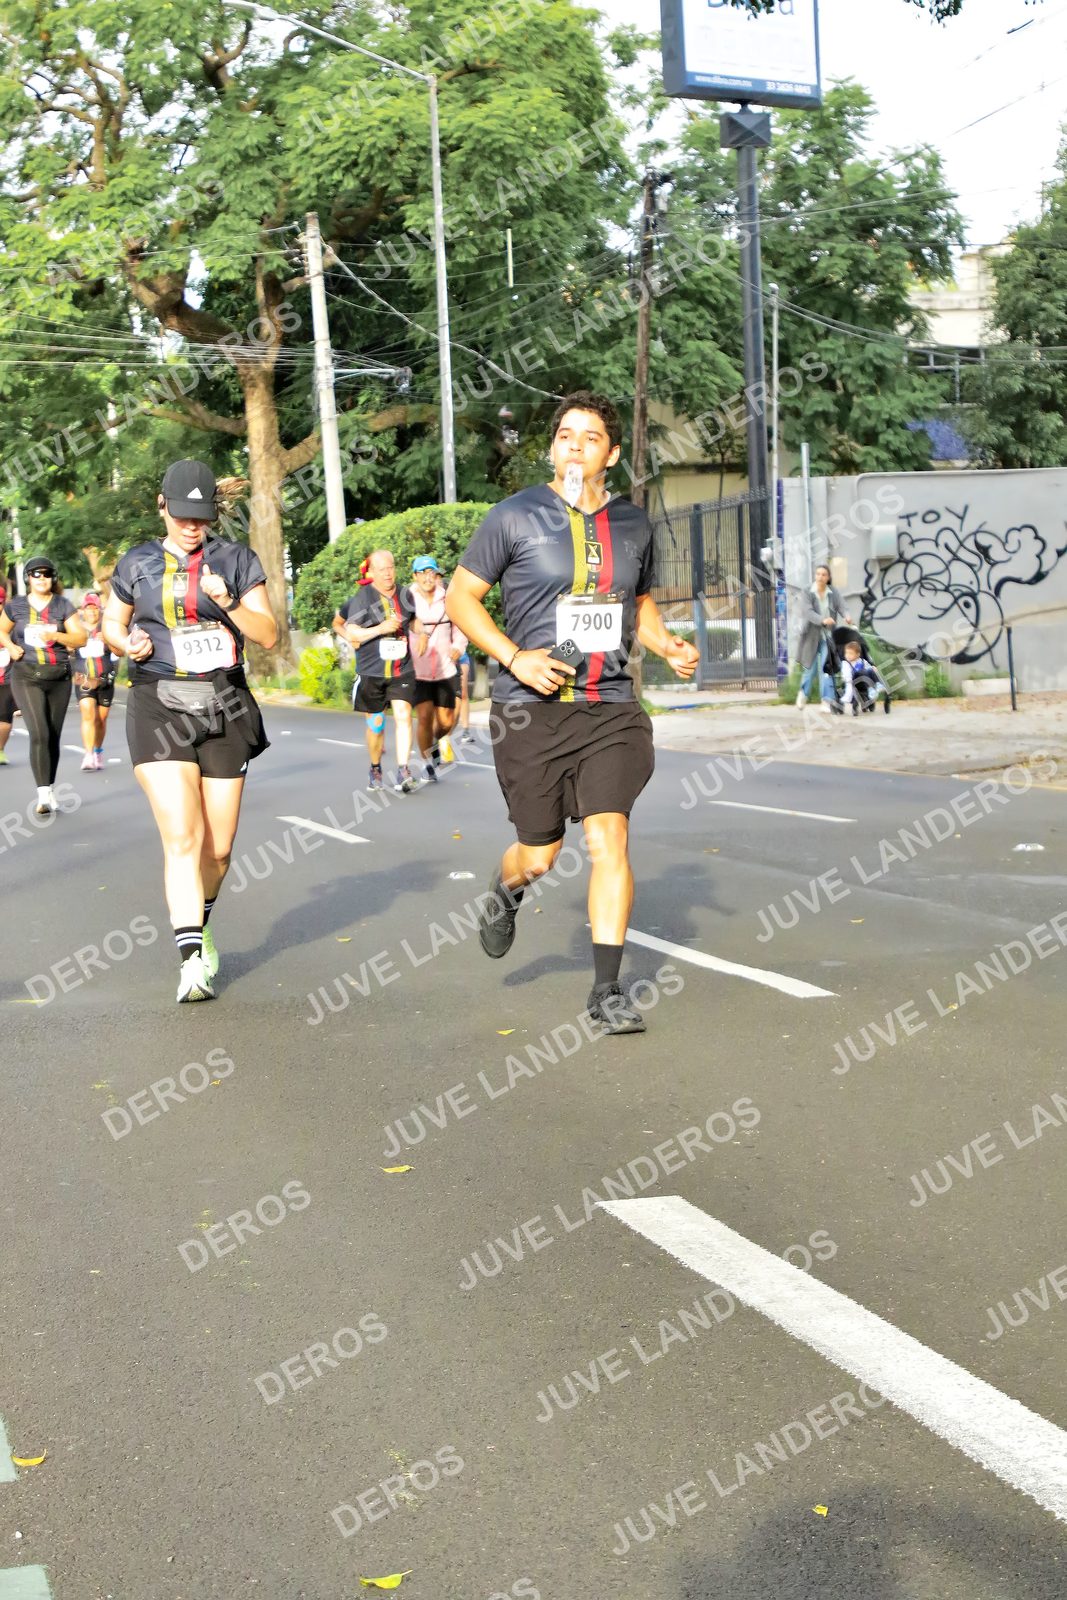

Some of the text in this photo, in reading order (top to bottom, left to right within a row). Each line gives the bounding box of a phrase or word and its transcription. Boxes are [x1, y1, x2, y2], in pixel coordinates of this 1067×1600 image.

[898, 504, 969, 532] TOY
[571, 612, 613, 631] 7900
[183, 636, 224, 656] 9312
